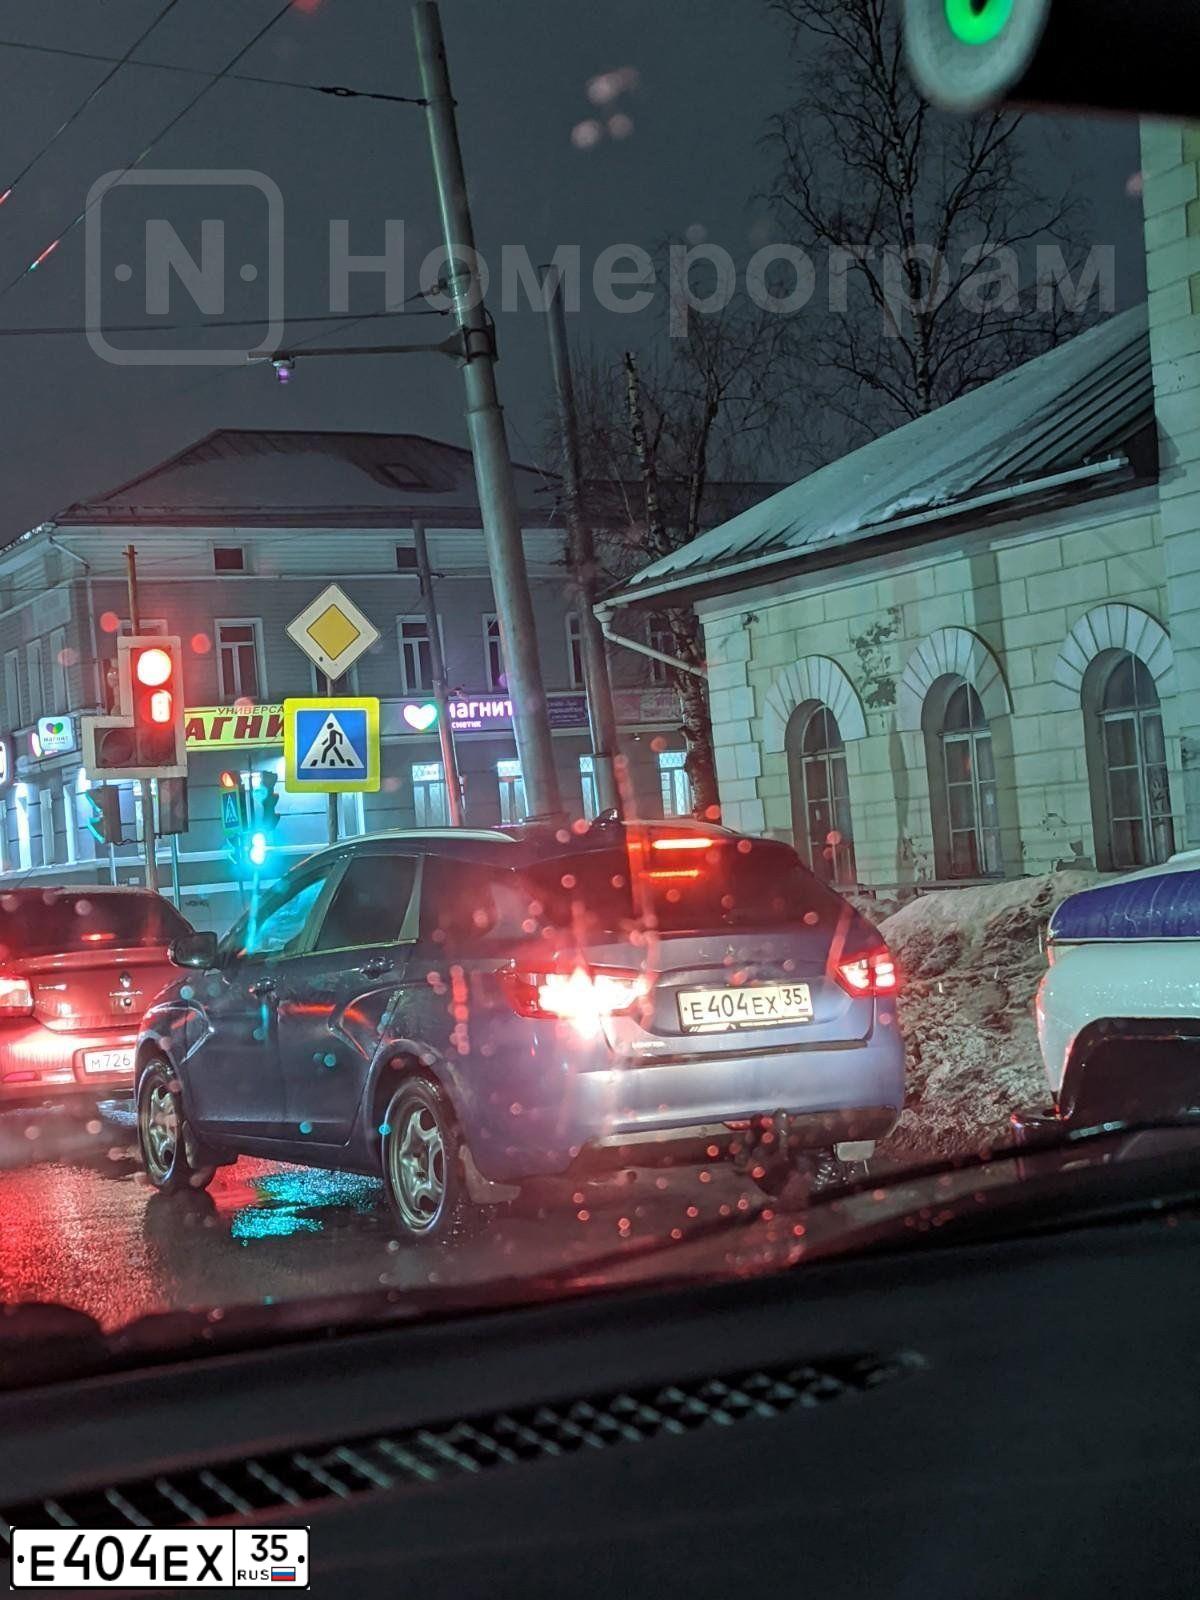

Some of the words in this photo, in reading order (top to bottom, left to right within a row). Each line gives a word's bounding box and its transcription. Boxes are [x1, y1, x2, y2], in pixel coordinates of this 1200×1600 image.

[216, 705, 284, 716] УНИВЕРСА
[184, 715, 284, 740] АГНИ
[690, 993, 778, 1020] Е404ЕХ
[782, 988, 802, 1006] 35
